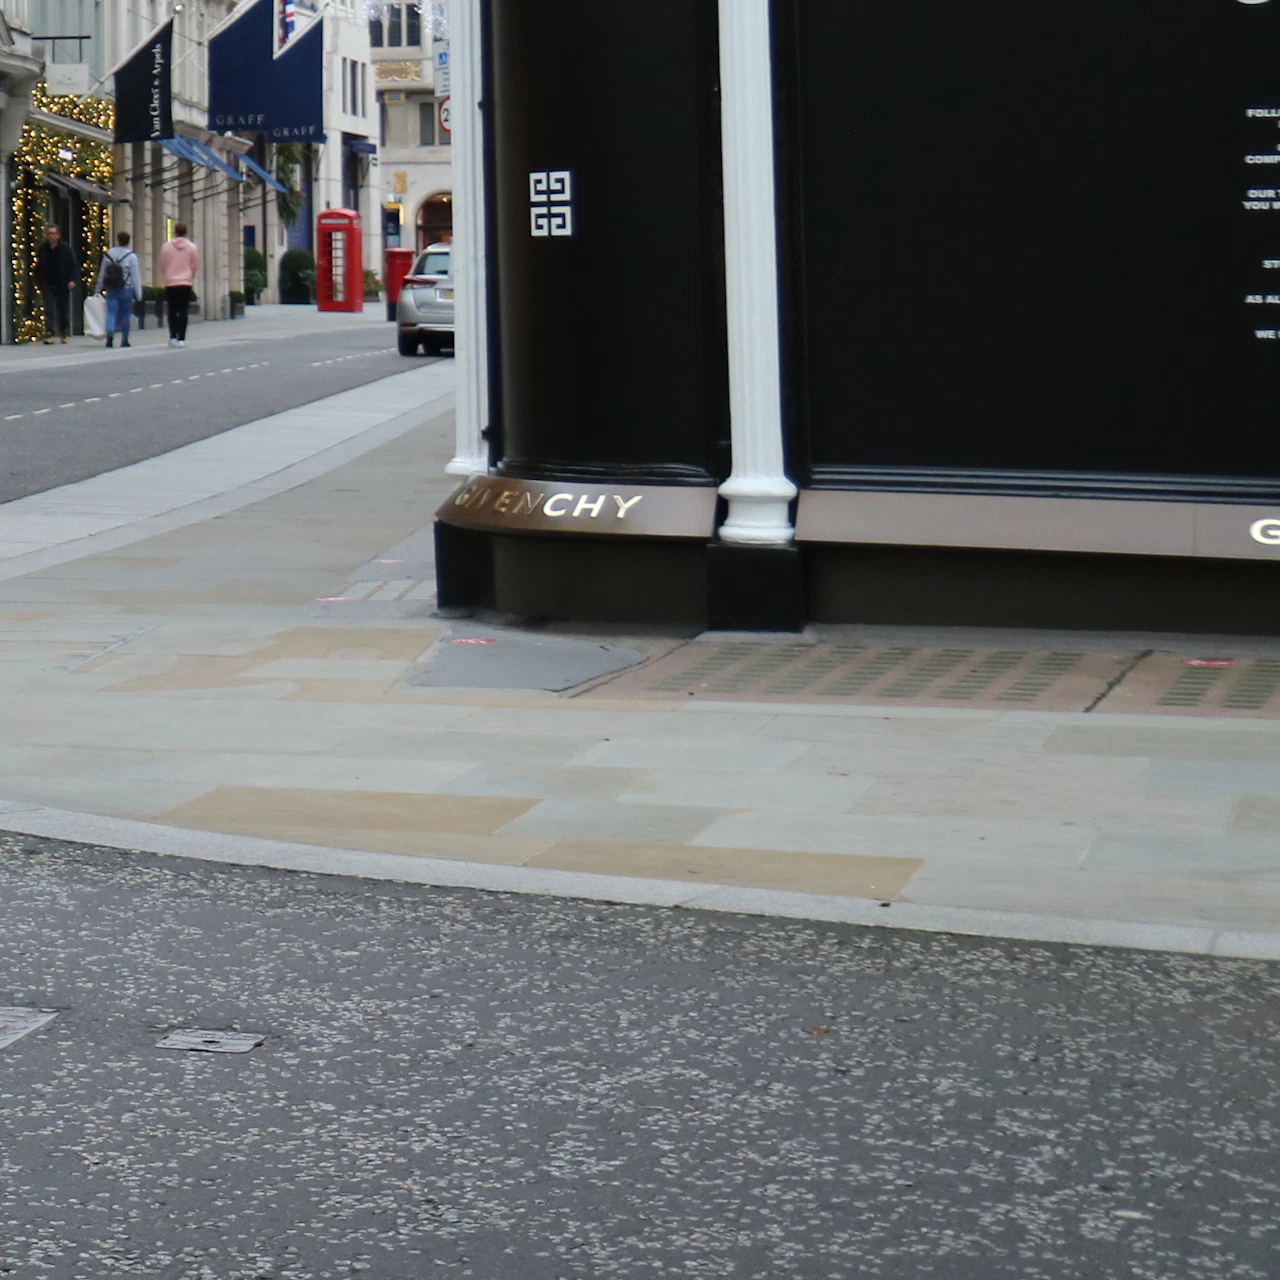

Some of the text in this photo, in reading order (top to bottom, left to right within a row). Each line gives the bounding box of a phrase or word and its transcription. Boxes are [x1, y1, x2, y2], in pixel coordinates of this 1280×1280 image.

[148, 86, 160, 116] Cleef
[214, 113, 266, 126] GRAFF
[149, 116, 161, 138] Van
[272, 125, 318, 138] GRAFF
[1243, 294, 1264, 304] AS
